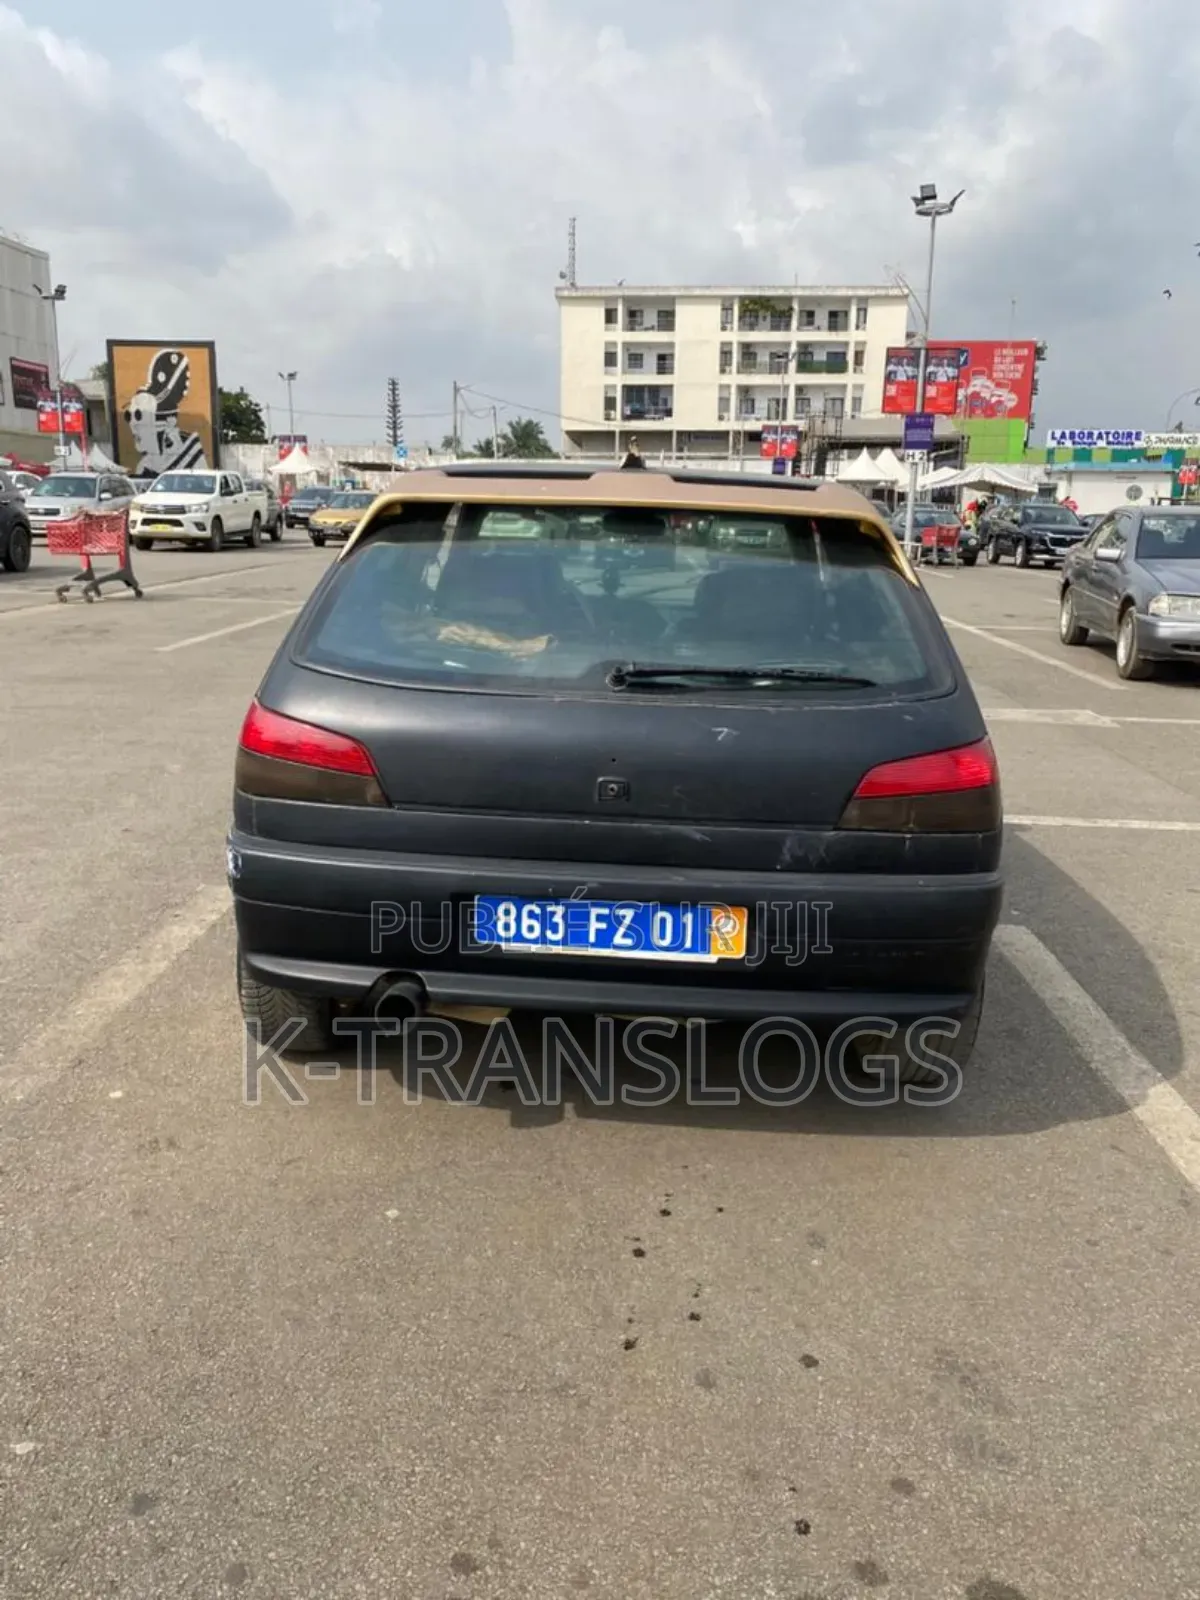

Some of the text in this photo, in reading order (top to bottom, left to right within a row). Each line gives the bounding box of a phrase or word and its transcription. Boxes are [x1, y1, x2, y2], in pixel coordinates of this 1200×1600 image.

[1051, 430, 1143, 441] LABORATOIRE
[496, 901, 694, 949] 863 FZ 01
